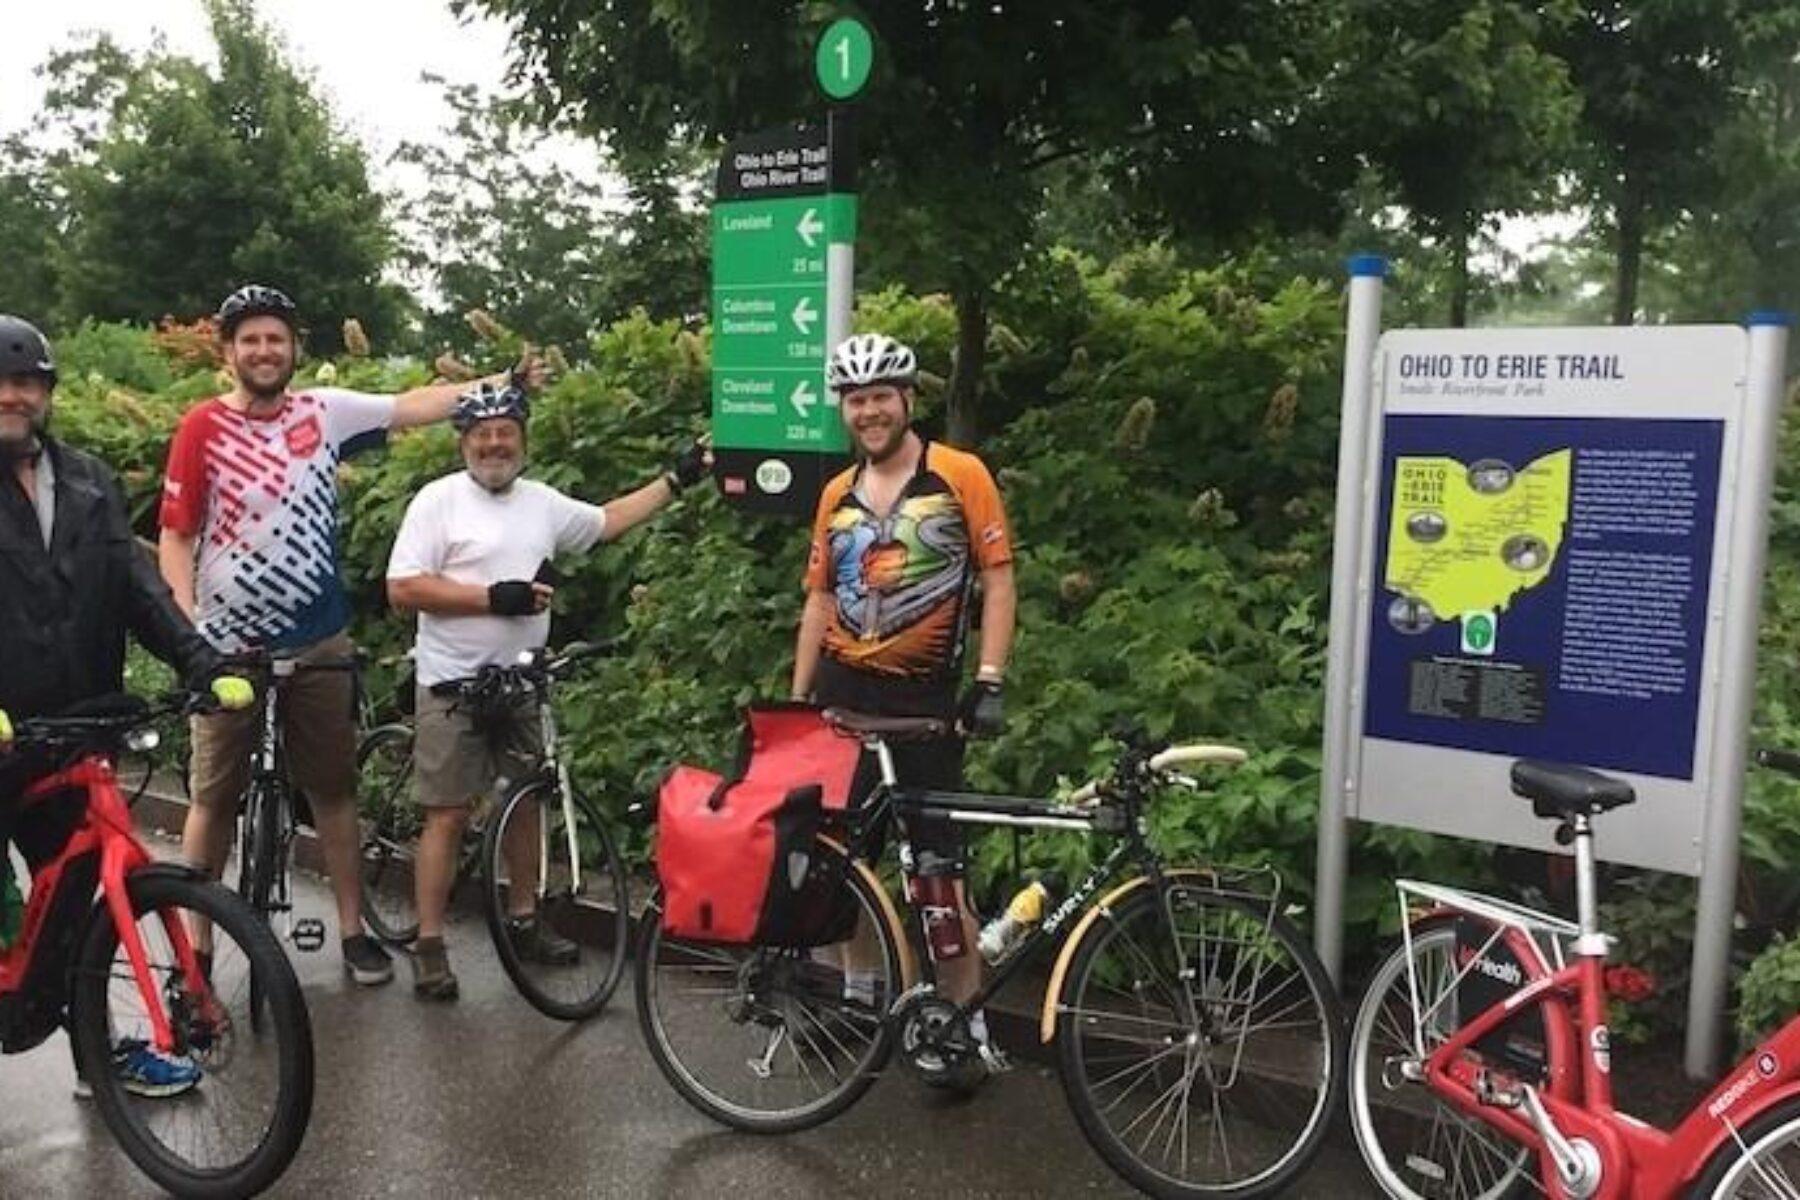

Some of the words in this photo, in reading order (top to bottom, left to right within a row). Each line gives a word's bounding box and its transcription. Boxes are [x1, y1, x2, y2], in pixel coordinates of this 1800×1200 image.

[836, 36, 849, 80] 1
[735, 153, 761, 170] Ohio
[762, 154, 775, 168] to
[777, 150, 799, 166] Erie
[801, 146, 828, 163] Trail
[740, 171, 767, 188] Ohio
[769, 169, 799, 185] River
[801, 166, 827, 183] Trail
[722, 213, 773, 230] Loveland
[1399, 354, 1453, 378] OHIO
[1462, 354, 1489, 379] TO
[1496, 355, 1548, 379] ERIE
[1556, 355, 1625, 381] TRAIL
